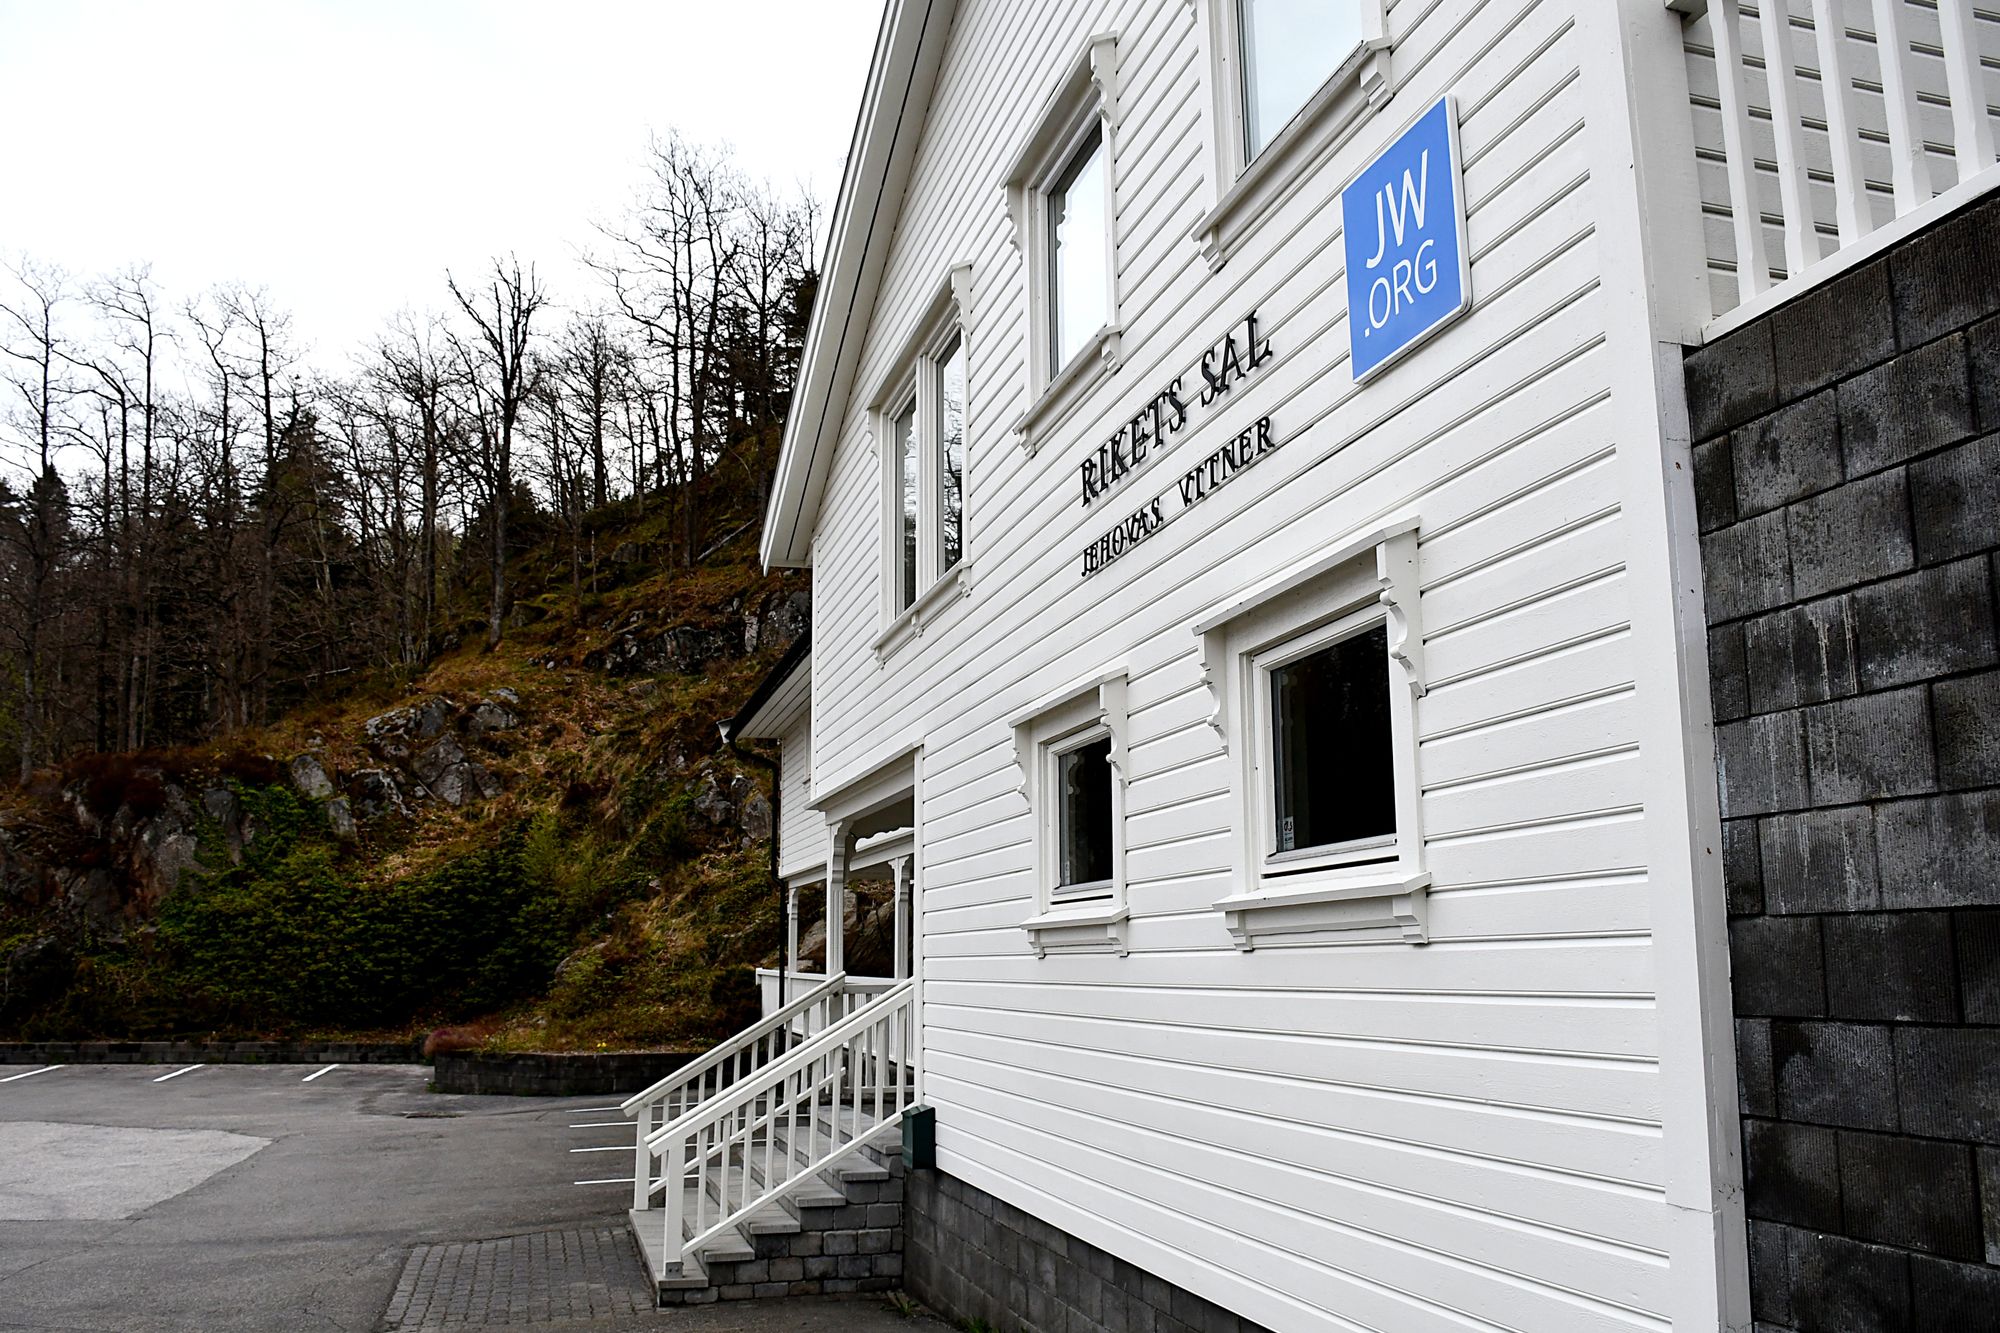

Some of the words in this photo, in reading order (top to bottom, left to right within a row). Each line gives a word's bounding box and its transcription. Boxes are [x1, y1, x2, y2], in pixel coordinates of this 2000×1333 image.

[1366, 148, 1428, 269] JW
[1364, 239, 1438, 338] .ORG
[1080, 375, 1187, 508] RIKETS
[1200, 309, 1273, 408] SAL
[1081, 495, 1164, 577] JEHOVAS
[1177, 415, 1275, 508] VITNER
